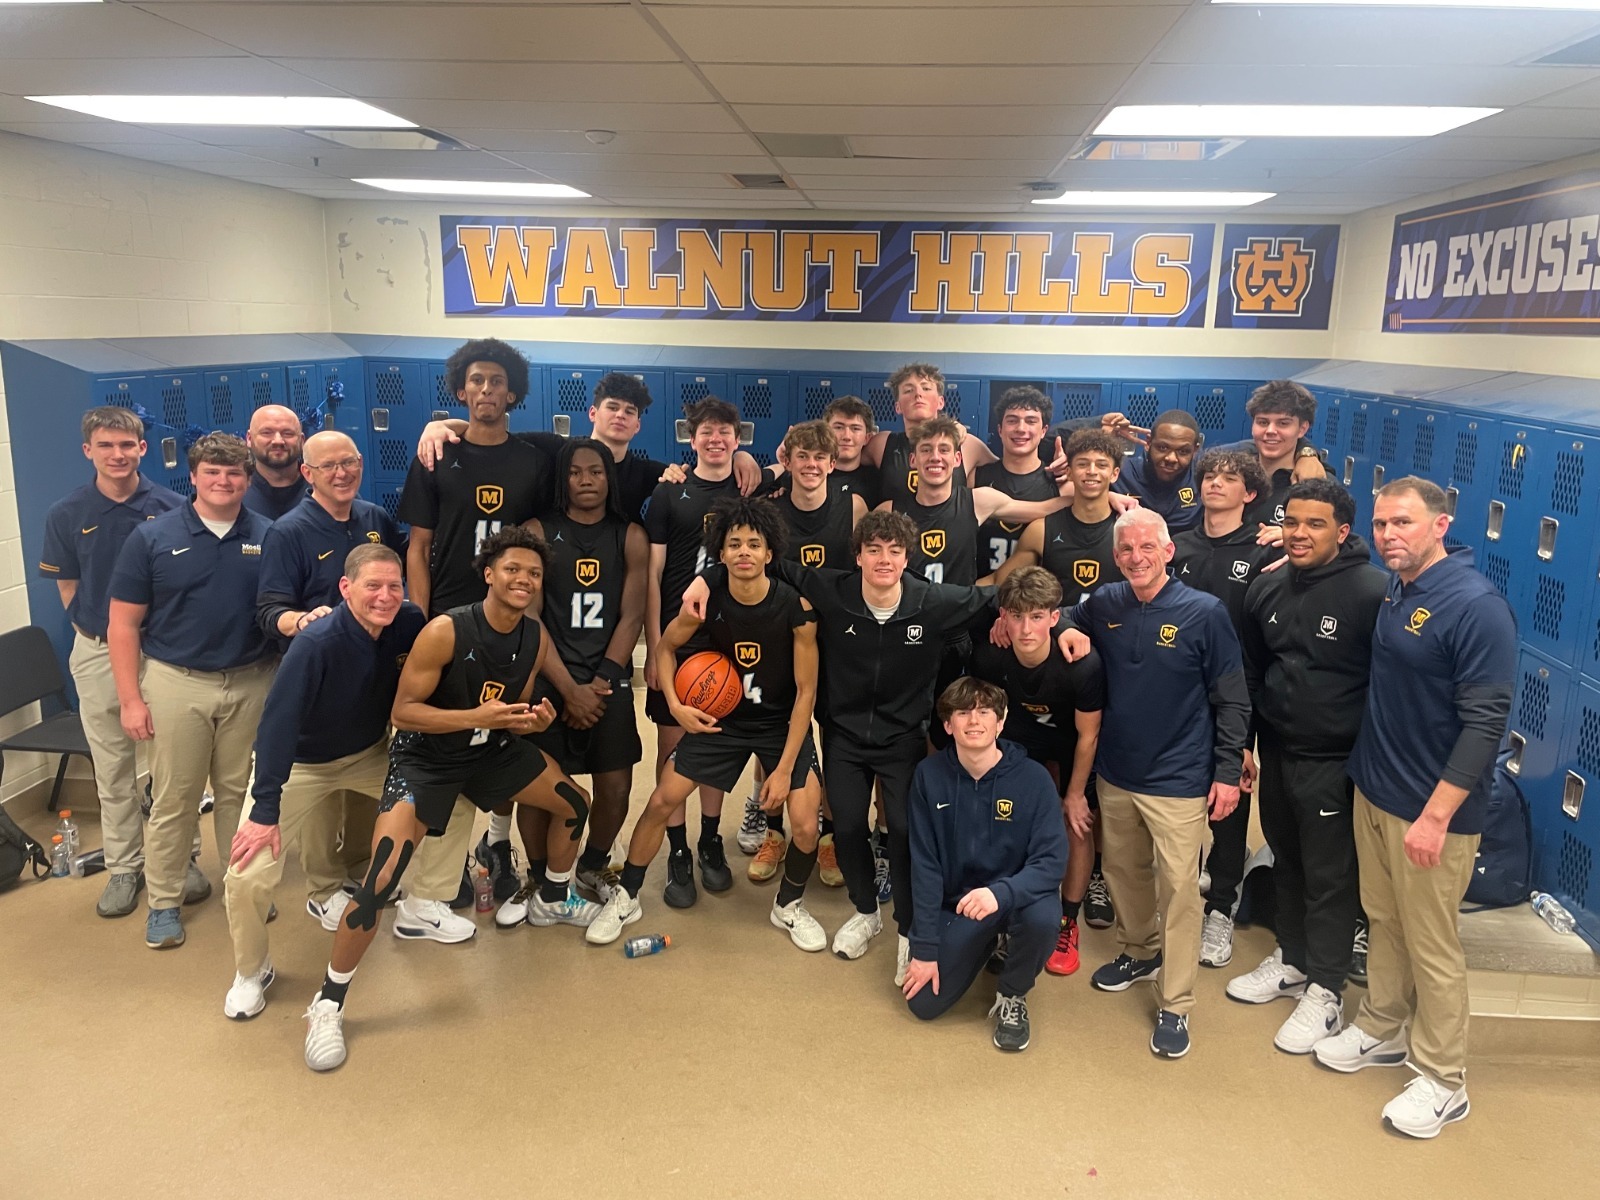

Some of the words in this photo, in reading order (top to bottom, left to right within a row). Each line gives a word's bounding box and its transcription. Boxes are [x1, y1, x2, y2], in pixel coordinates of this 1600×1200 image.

[1395, 239, 1437, 300] NO
[1442, 214, 1600, 298] EXCUSE
[456, 224, 881, 312] WALNUT
[908, 230, 1193, 317] HILLS
[481, 490, 498, 504] M
[926, 535, 942, 549] M
[805, 550, 821, 563] M
[580, 564, 595, 577] M
[1078, 565, 1095, 578] M
[570, 592, 604, 629] 12
[740, 647, 757, 660] M
[691, 670, 717, 709] Rawlings
[743, 672, 762, 704] 4
